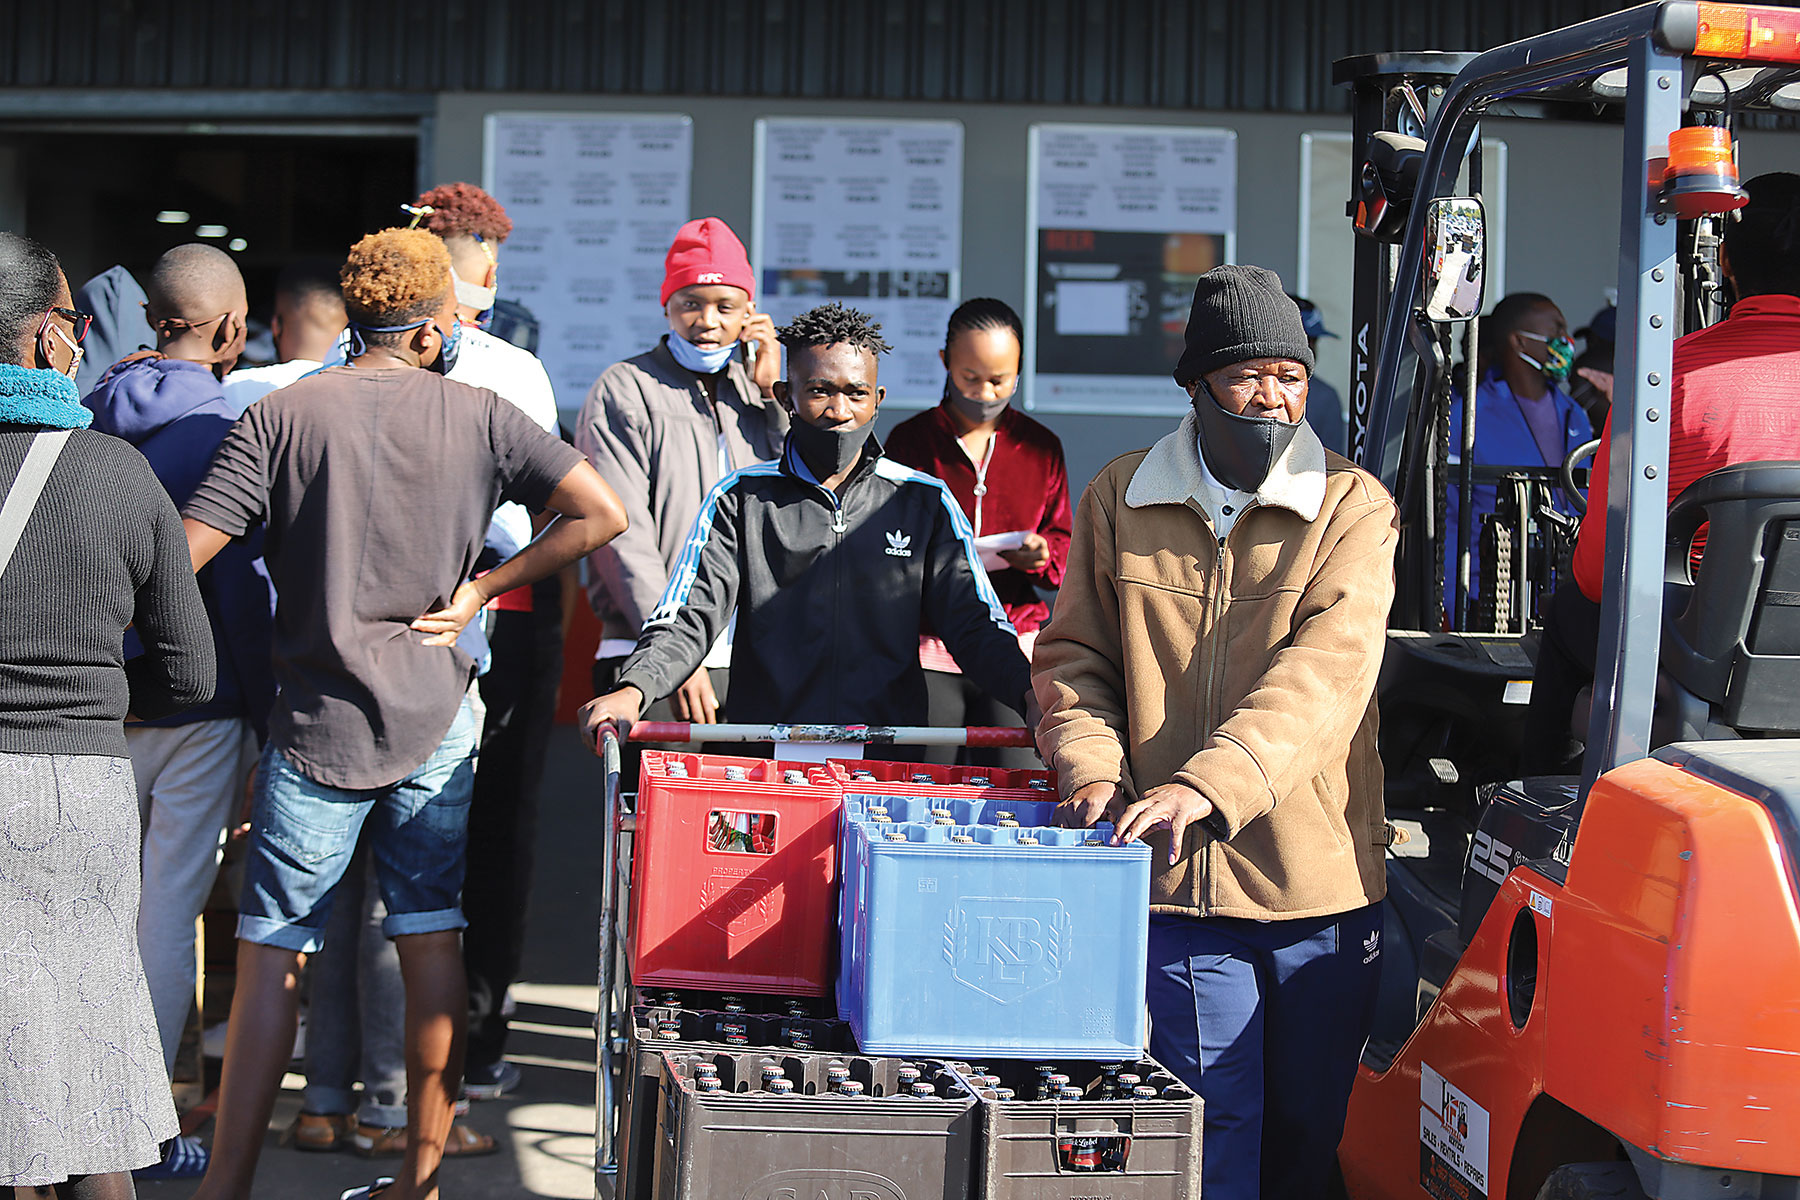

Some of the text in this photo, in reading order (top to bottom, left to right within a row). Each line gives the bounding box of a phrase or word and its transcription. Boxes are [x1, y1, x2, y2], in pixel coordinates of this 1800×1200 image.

[697, 272, 724, 284] KFC
[1354, 322, 1370, 467] OYOTA
[885, 547, 912, 557] adidas
[1470, 829, 1513, 886] 25
[1079, 1137, 1098, 1147] Label
[1423, 1126, 1437, 1148] SALES
[1440, 1140, 1461, 1168] RENTALS
[1463, 1160, 1485, 1187] REPAIRS
